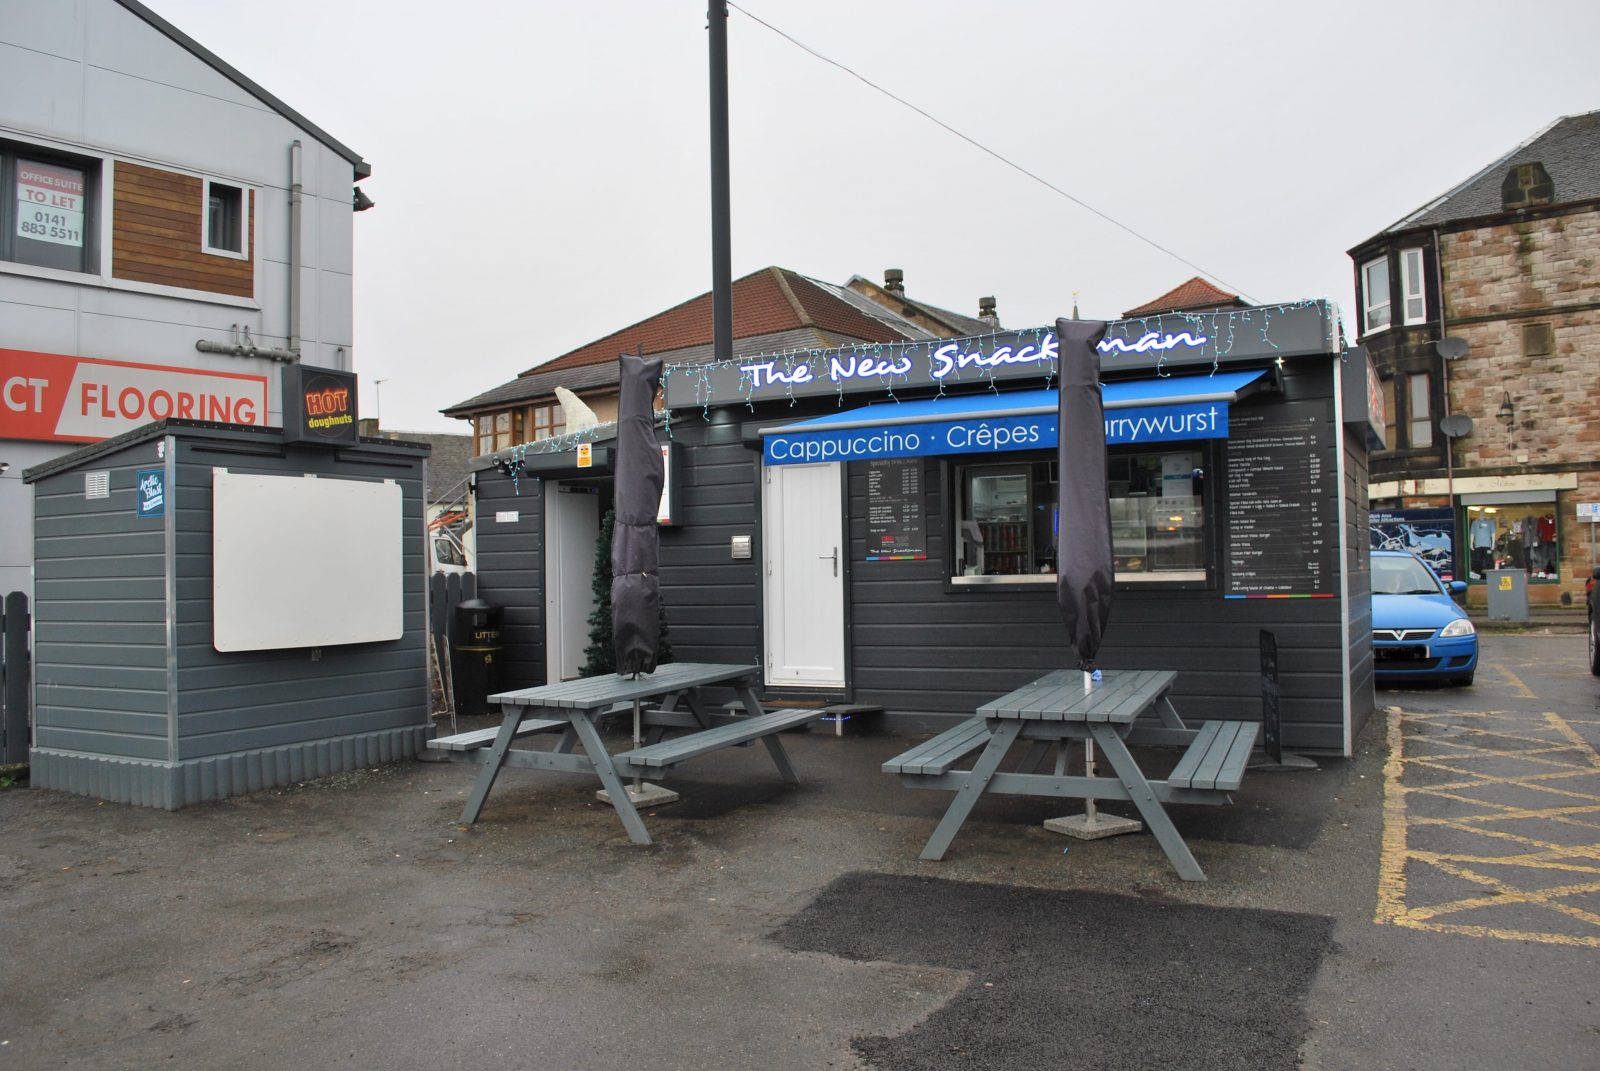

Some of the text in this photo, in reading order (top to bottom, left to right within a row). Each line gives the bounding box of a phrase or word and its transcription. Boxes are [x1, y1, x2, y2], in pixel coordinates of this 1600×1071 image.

[21, 171, 84, 191] OFFICE SUITE
[26, 189, 76, 208] TO LET
[35, 212, 66, 227] 0141
[21, 221, 79, 241] 883 5511
[741, 362, 812, 387] The
[830, 357, 911, 382] New
[81, 383, 257, 425] FLOORING
[306, 390, 348, 415] HOT
[308, 414, 353, 428] doughnuts
[770, 406, 1219, 461] Cappuccino Crêpes rrywurst
